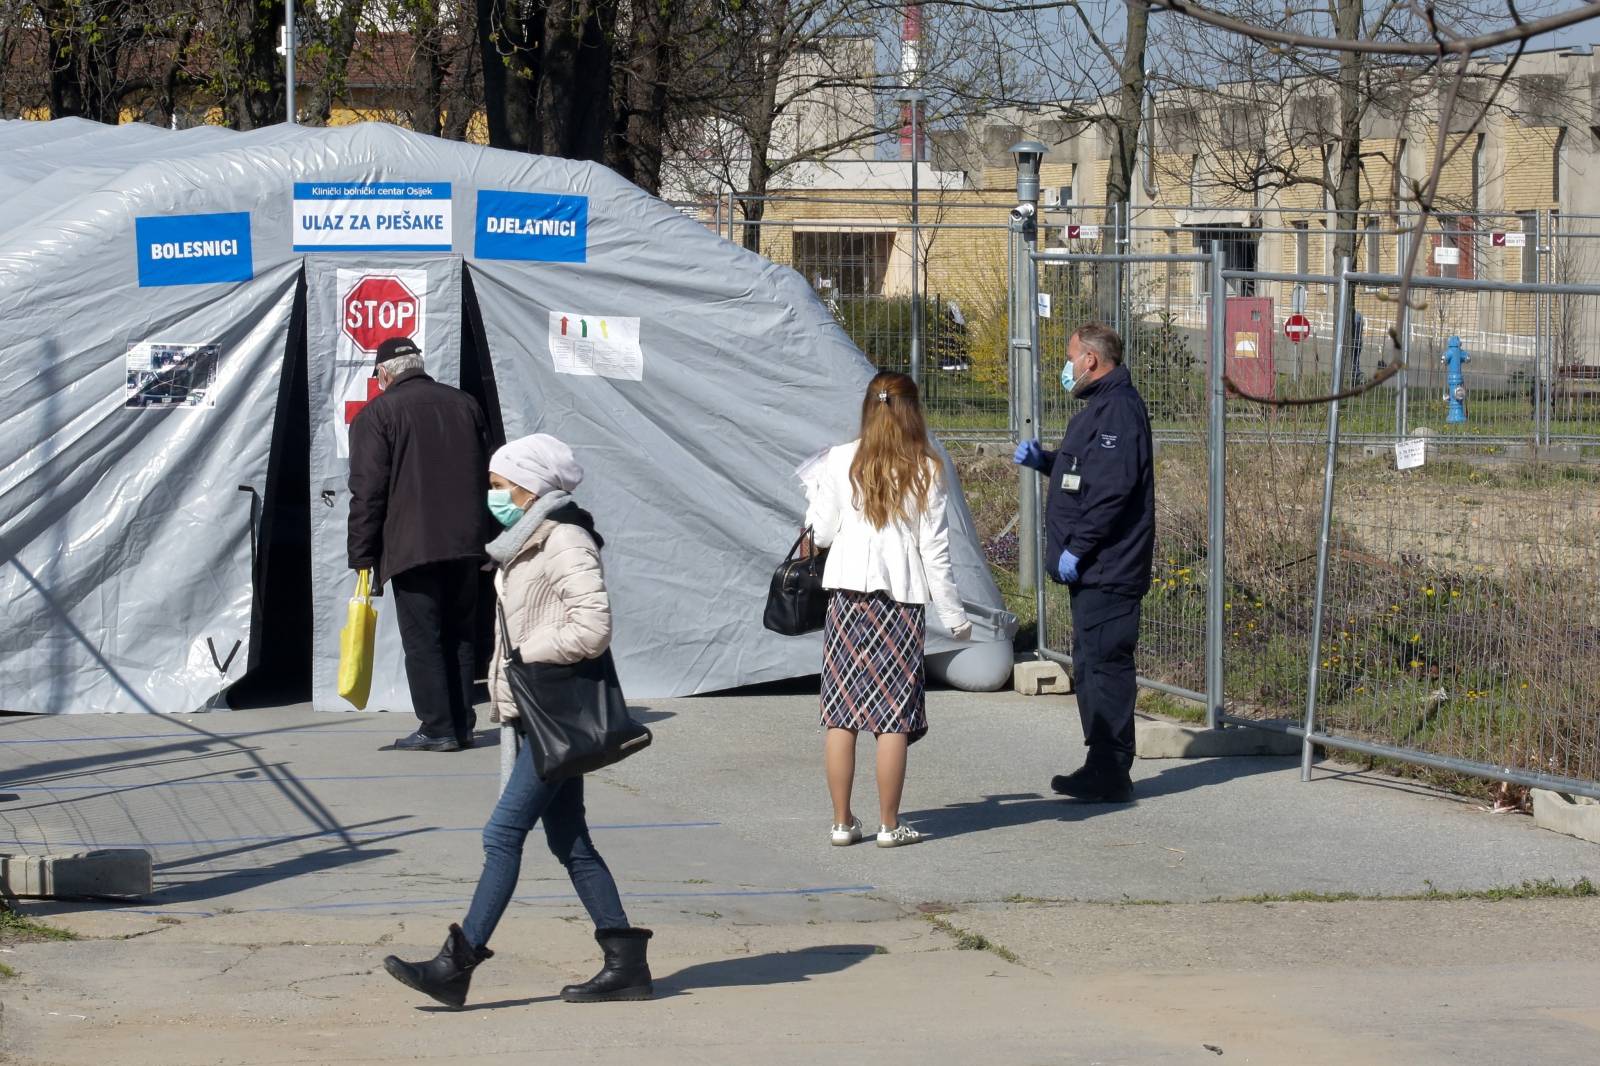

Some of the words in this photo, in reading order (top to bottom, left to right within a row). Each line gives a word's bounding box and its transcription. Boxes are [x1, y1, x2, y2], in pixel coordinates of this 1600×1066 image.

[311, 186, 341, 196] Klinički
[343, 186, 375, 196] bolnički
[377, 187, 404, 196] centar
[406, 186, 432, 197] Osijek
[302, 215, 343, 230] ULAZ
[349, 215, 371, 230] ZA
[376, 210, 444, 230] PJEŠAKE
[486, 216, 576, 237] DJELATNICI
[151, 239, 238, 260] BOLESNICI
[347, 299, 414, 329] STOP
